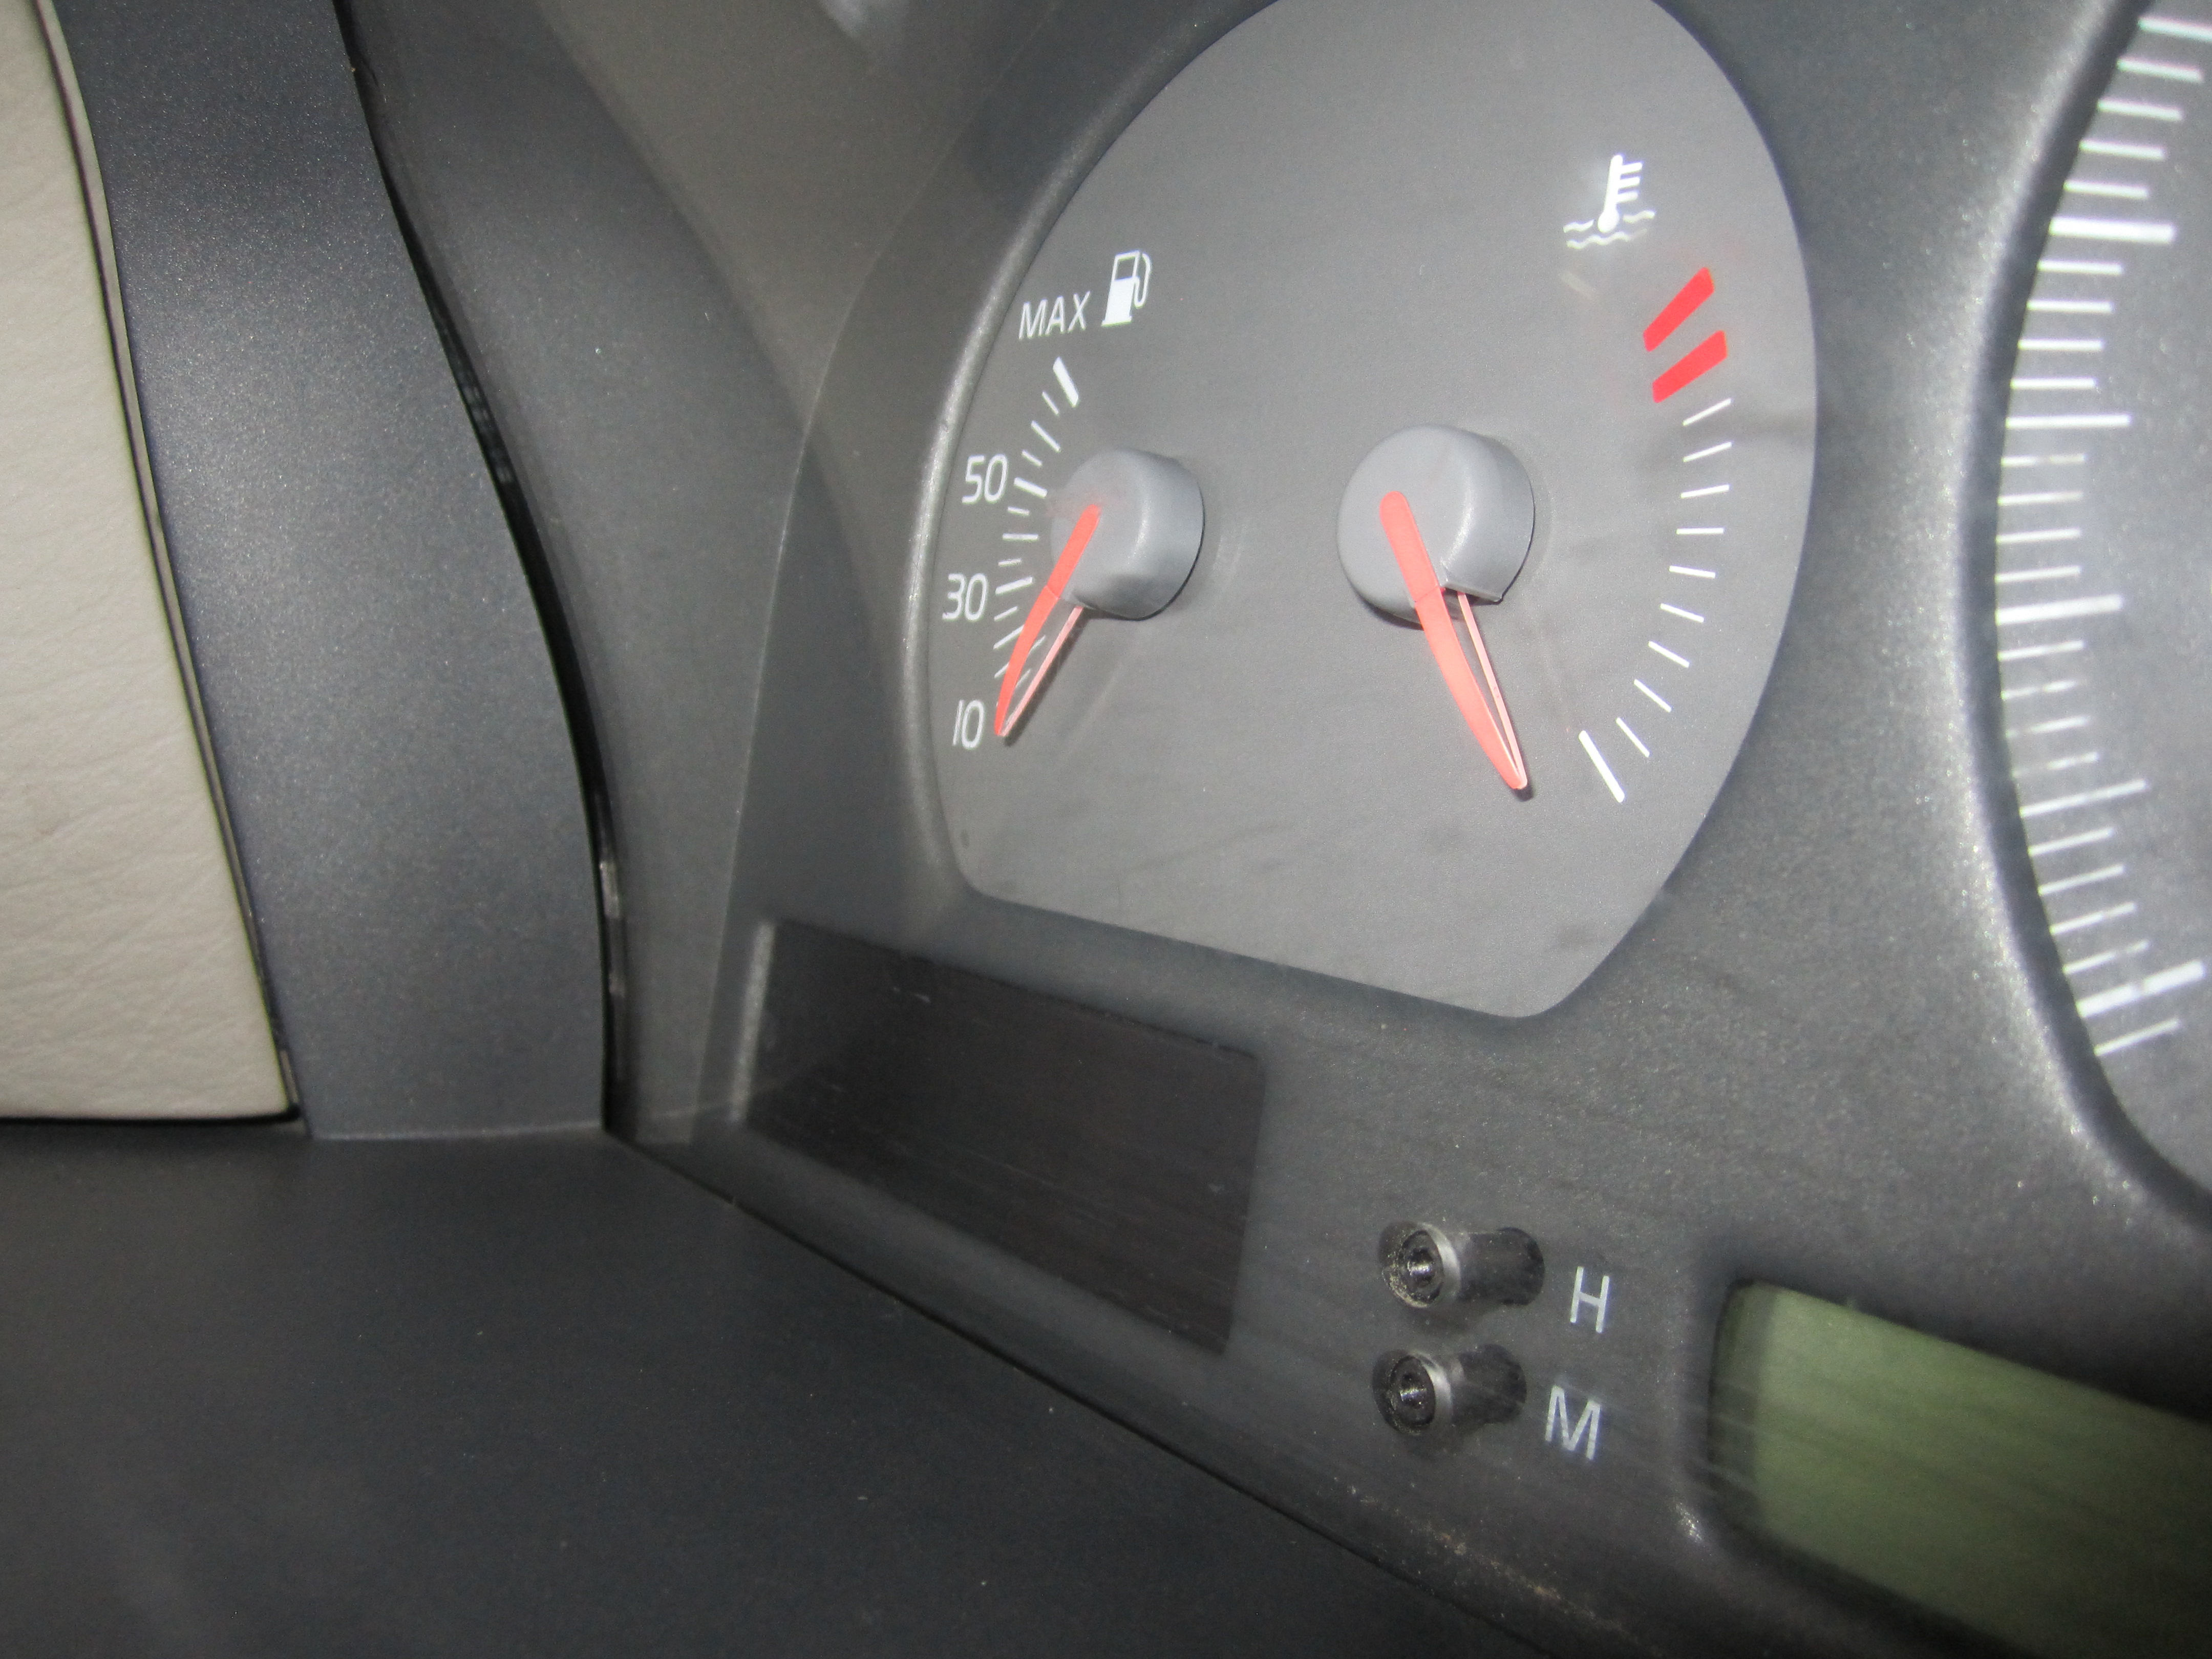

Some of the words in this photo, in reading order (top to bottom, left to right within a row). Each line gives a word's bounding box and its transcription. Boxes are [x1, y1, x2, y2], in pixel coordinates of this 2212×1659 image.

[1018, 290, 1091, 340] MAX
[962, 453, 1009, 504] 50
[942, 572, 989, 622] 30
[952, 699, 985, 750] 10
[1569, 1266, 1610, 1333] H
[1544, 1385, 1602, 1461] M
